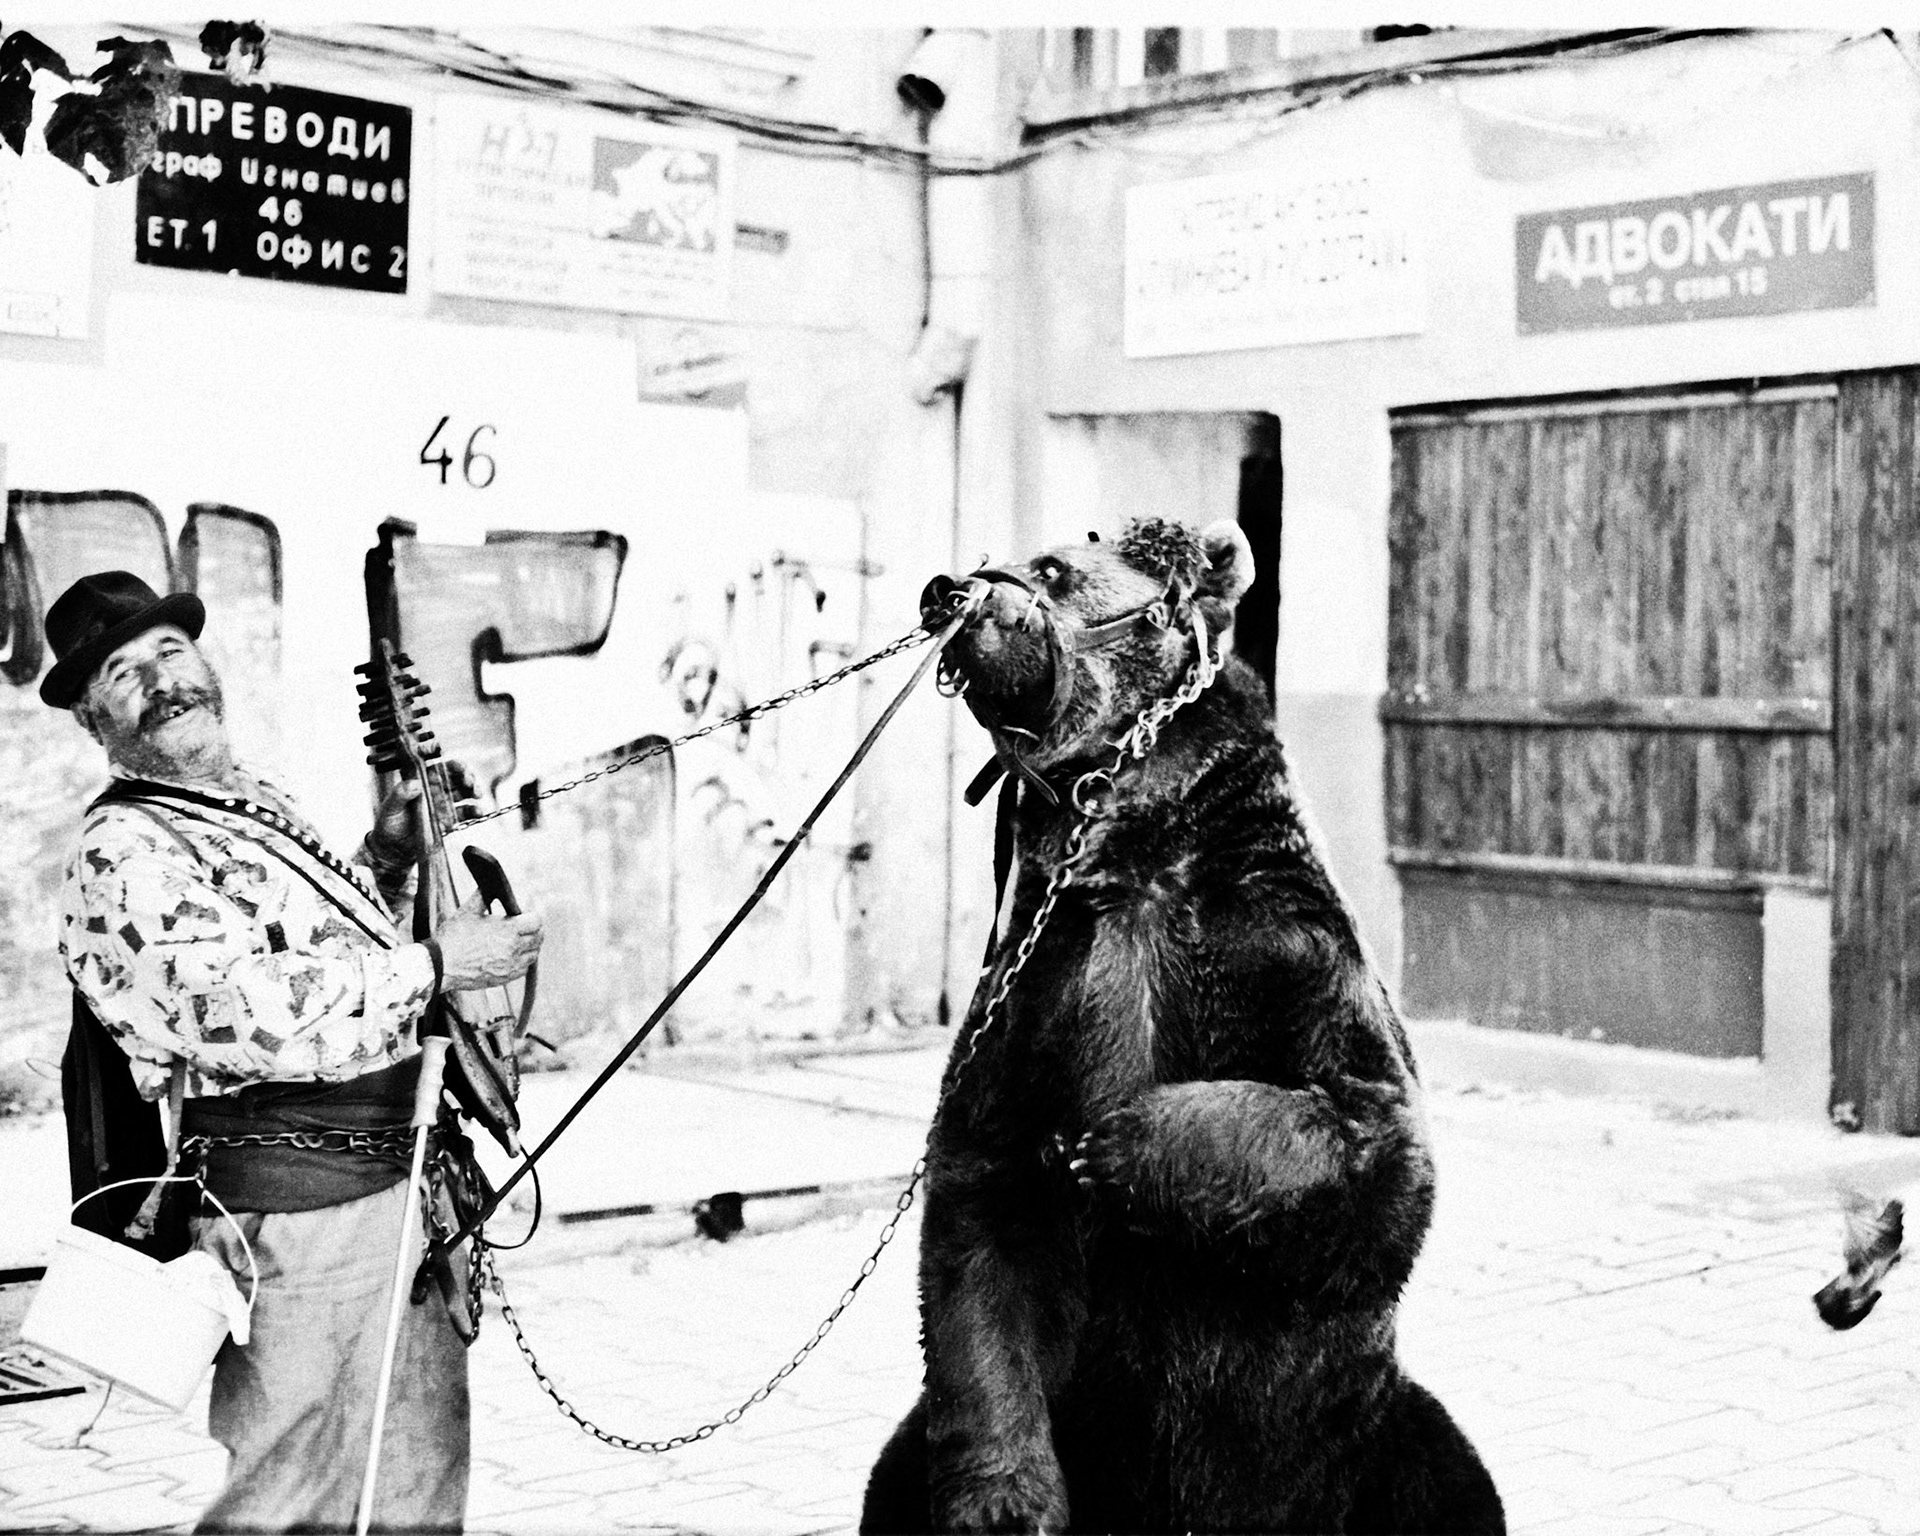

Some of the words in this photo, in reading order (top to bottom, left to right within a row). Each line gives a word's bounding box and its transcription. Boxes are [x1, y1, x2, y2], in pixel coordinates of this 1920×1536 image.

[168, 95, 391, 162] ПРЕВОДИ
[150, 150, 223, 183] граф
[258, 195, 304, 227] 46
[1534, 191, 1853, 290] АДВОКАТИ
[201, 218, 218, 253] 1
[256, 231, 372, 274] ОФИС
[388, 245, 407, 279] 2
[420, 415, 496, 489] 46
